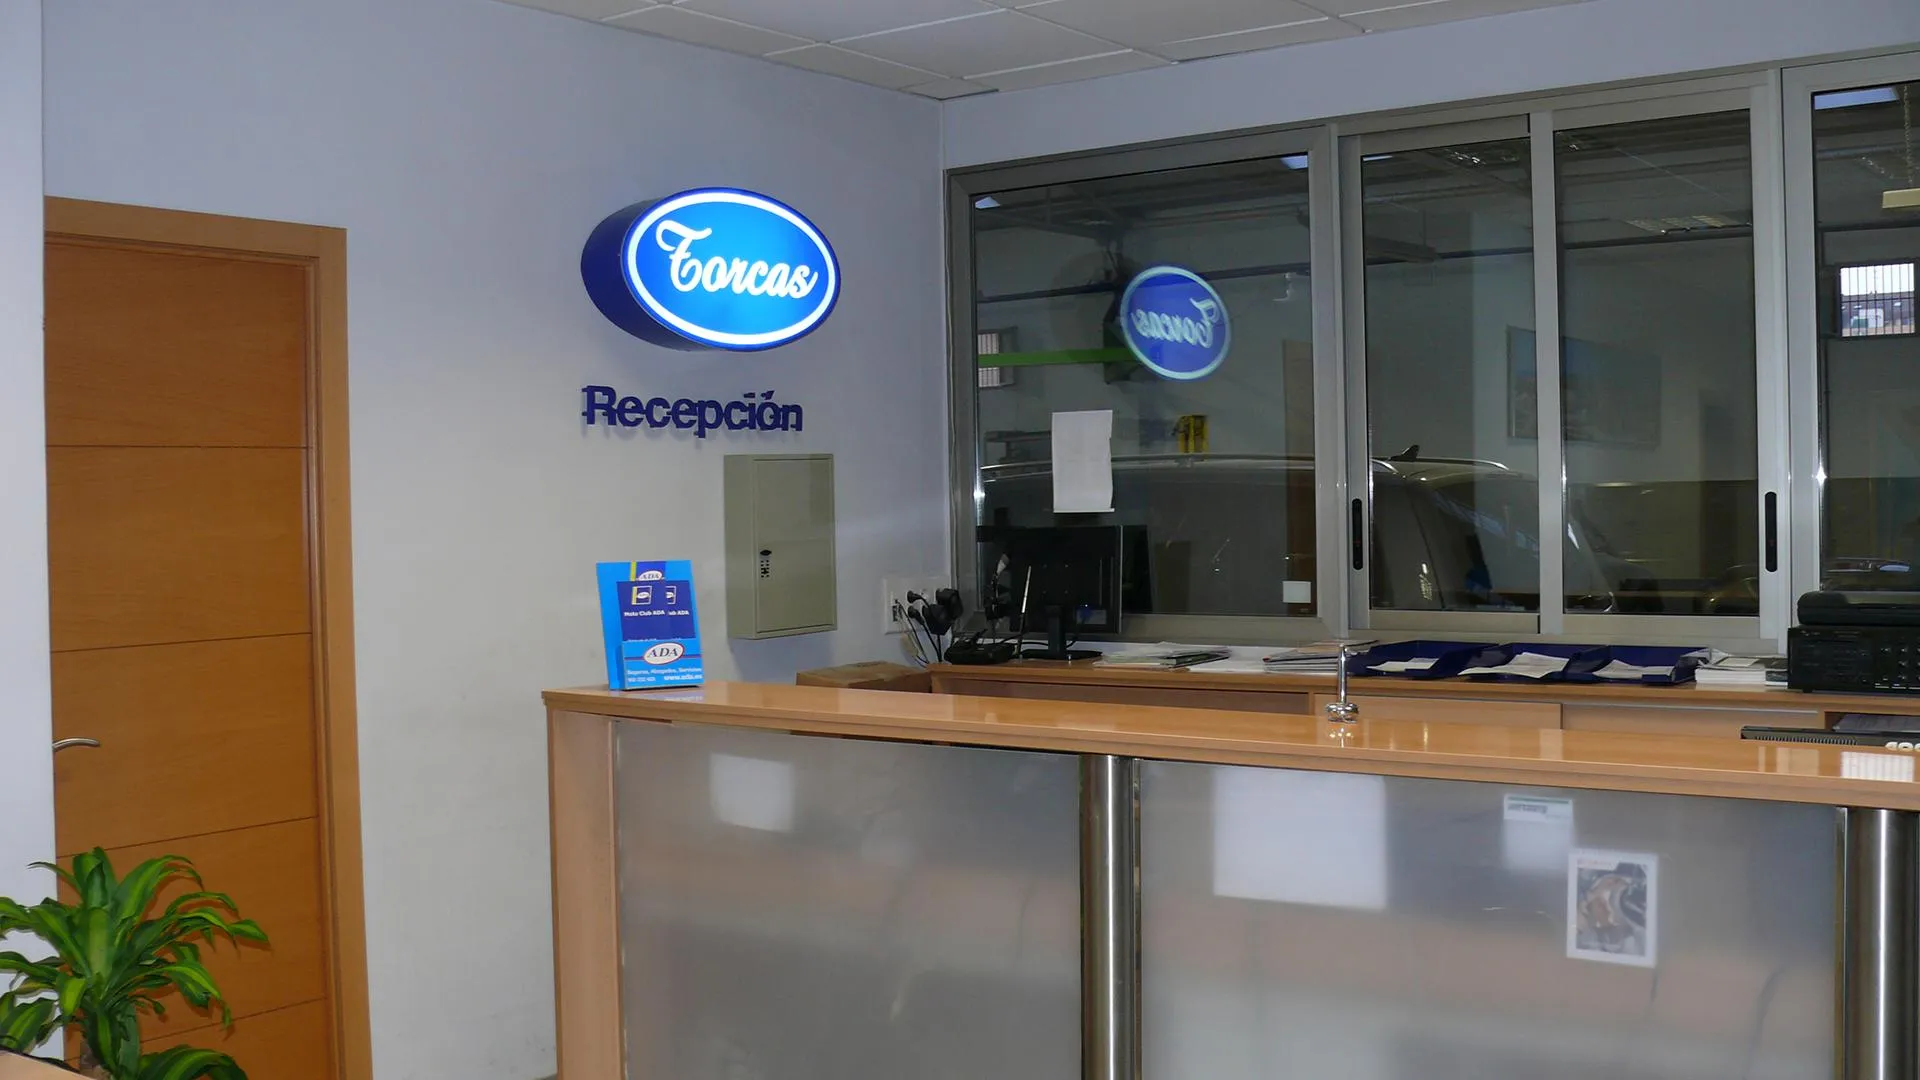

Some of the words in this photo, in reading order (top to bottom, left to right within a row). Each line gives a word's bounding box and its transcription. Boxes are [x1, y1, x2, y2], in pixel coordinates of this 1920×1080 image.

[655, 219, 819, 299] Torcas
[581, 385, 803, 438] Recepción
[647, 647, 678, 658] ADA
